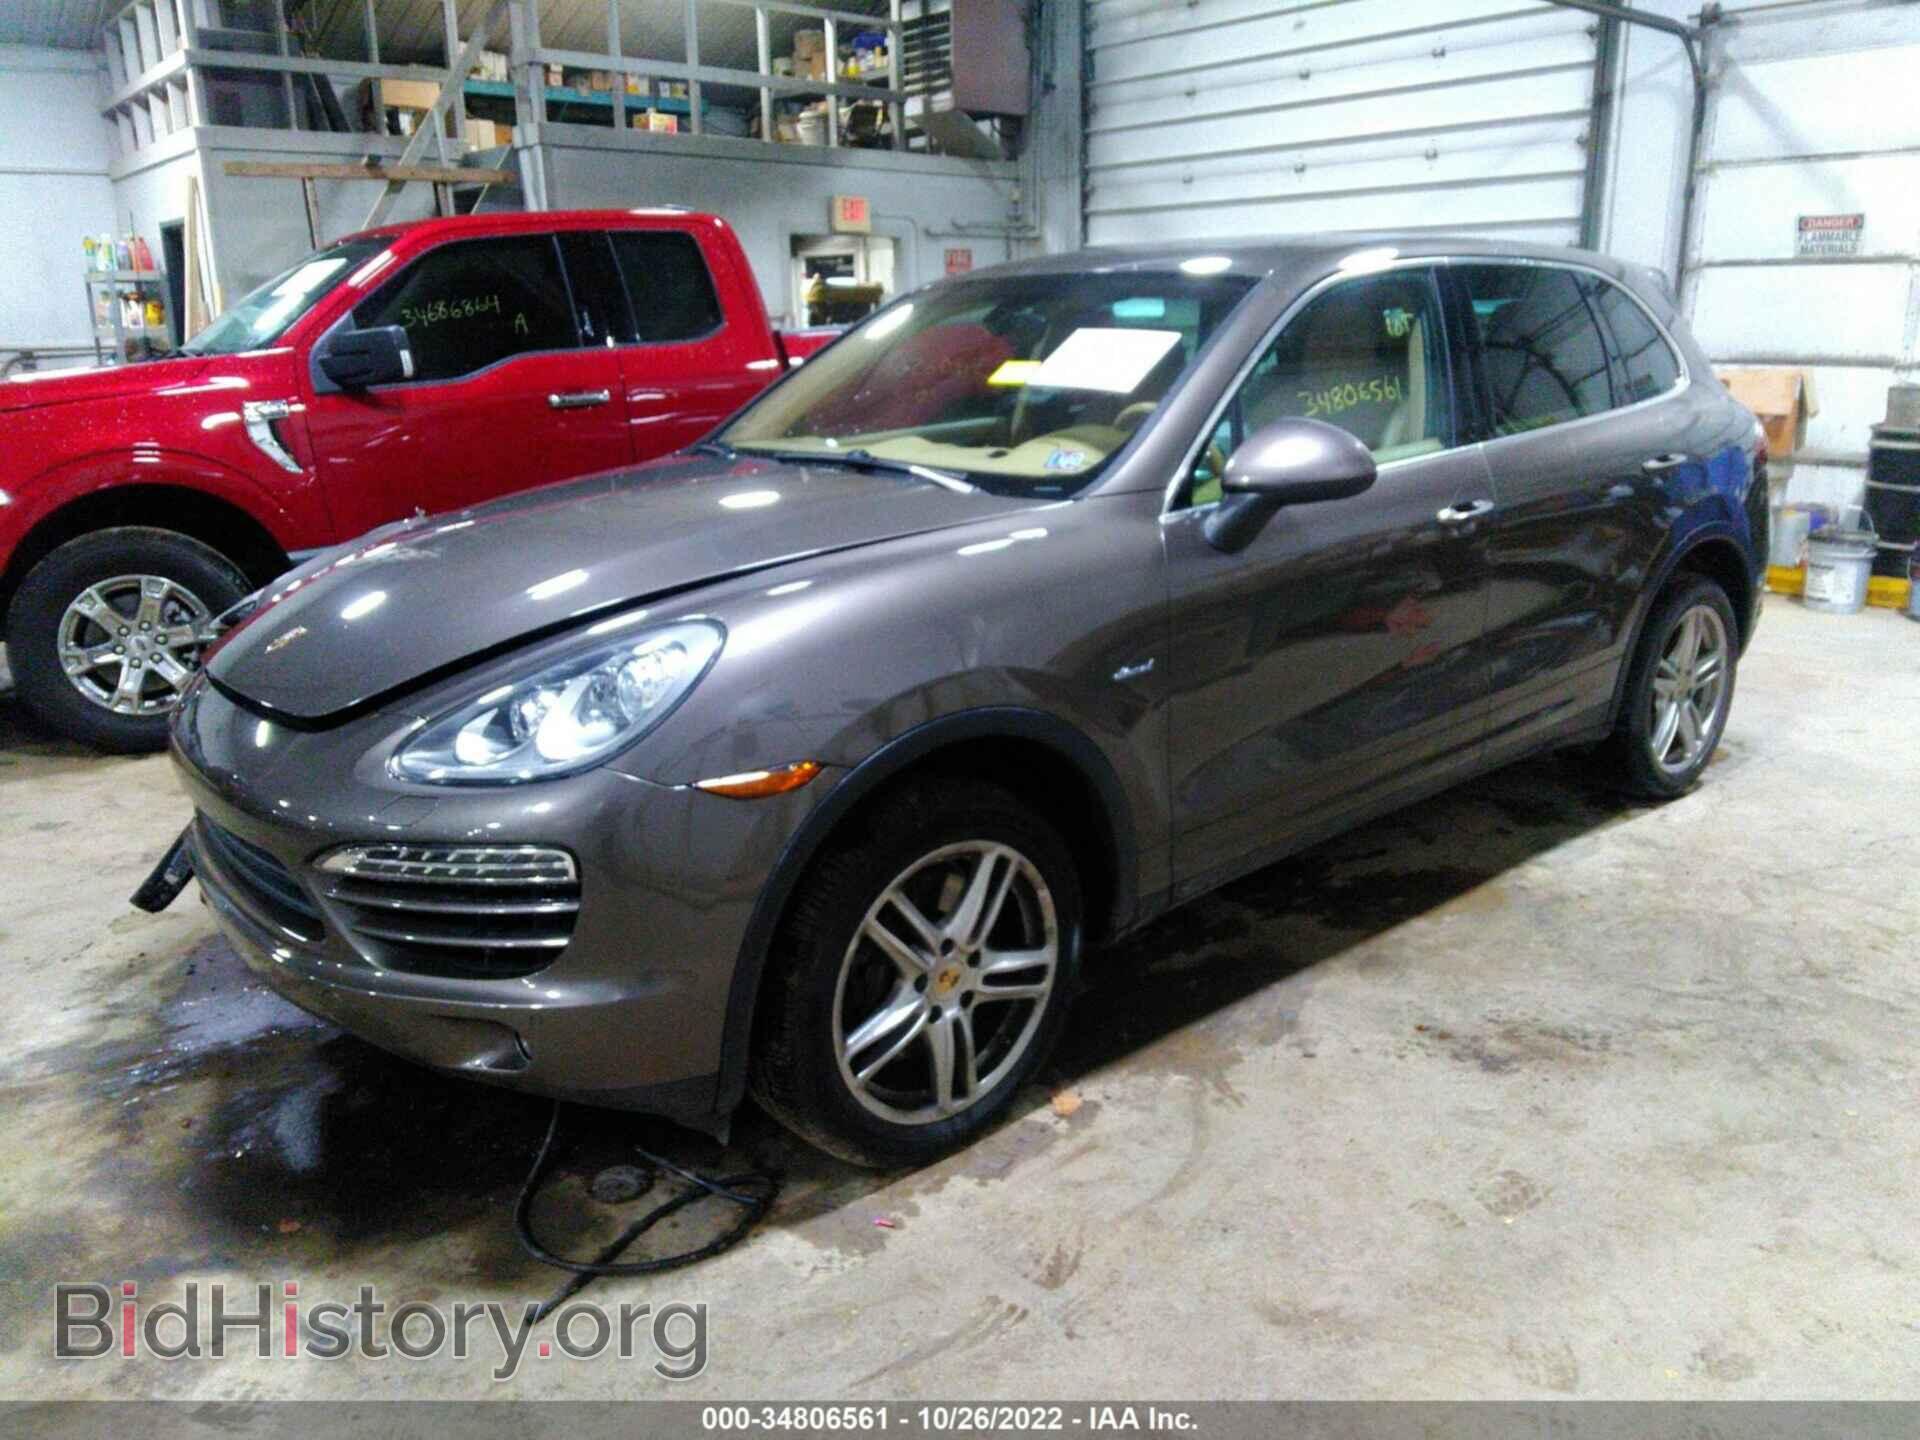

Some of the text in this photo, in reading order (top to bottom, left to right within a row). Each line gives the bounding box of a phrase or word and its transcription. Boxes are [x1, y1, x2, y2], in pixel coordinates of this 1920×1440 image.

[1807, 216, 1855, 229] DANGER
[1798, 230, 1860, 243] FLAMMABLE
[1799, 243, 1857, 255] MATERIALS
[401, 295, 502, 328] 34686864
[514, 313, 529, 335] A
[1296, 376, 1402, 417] 34806561
